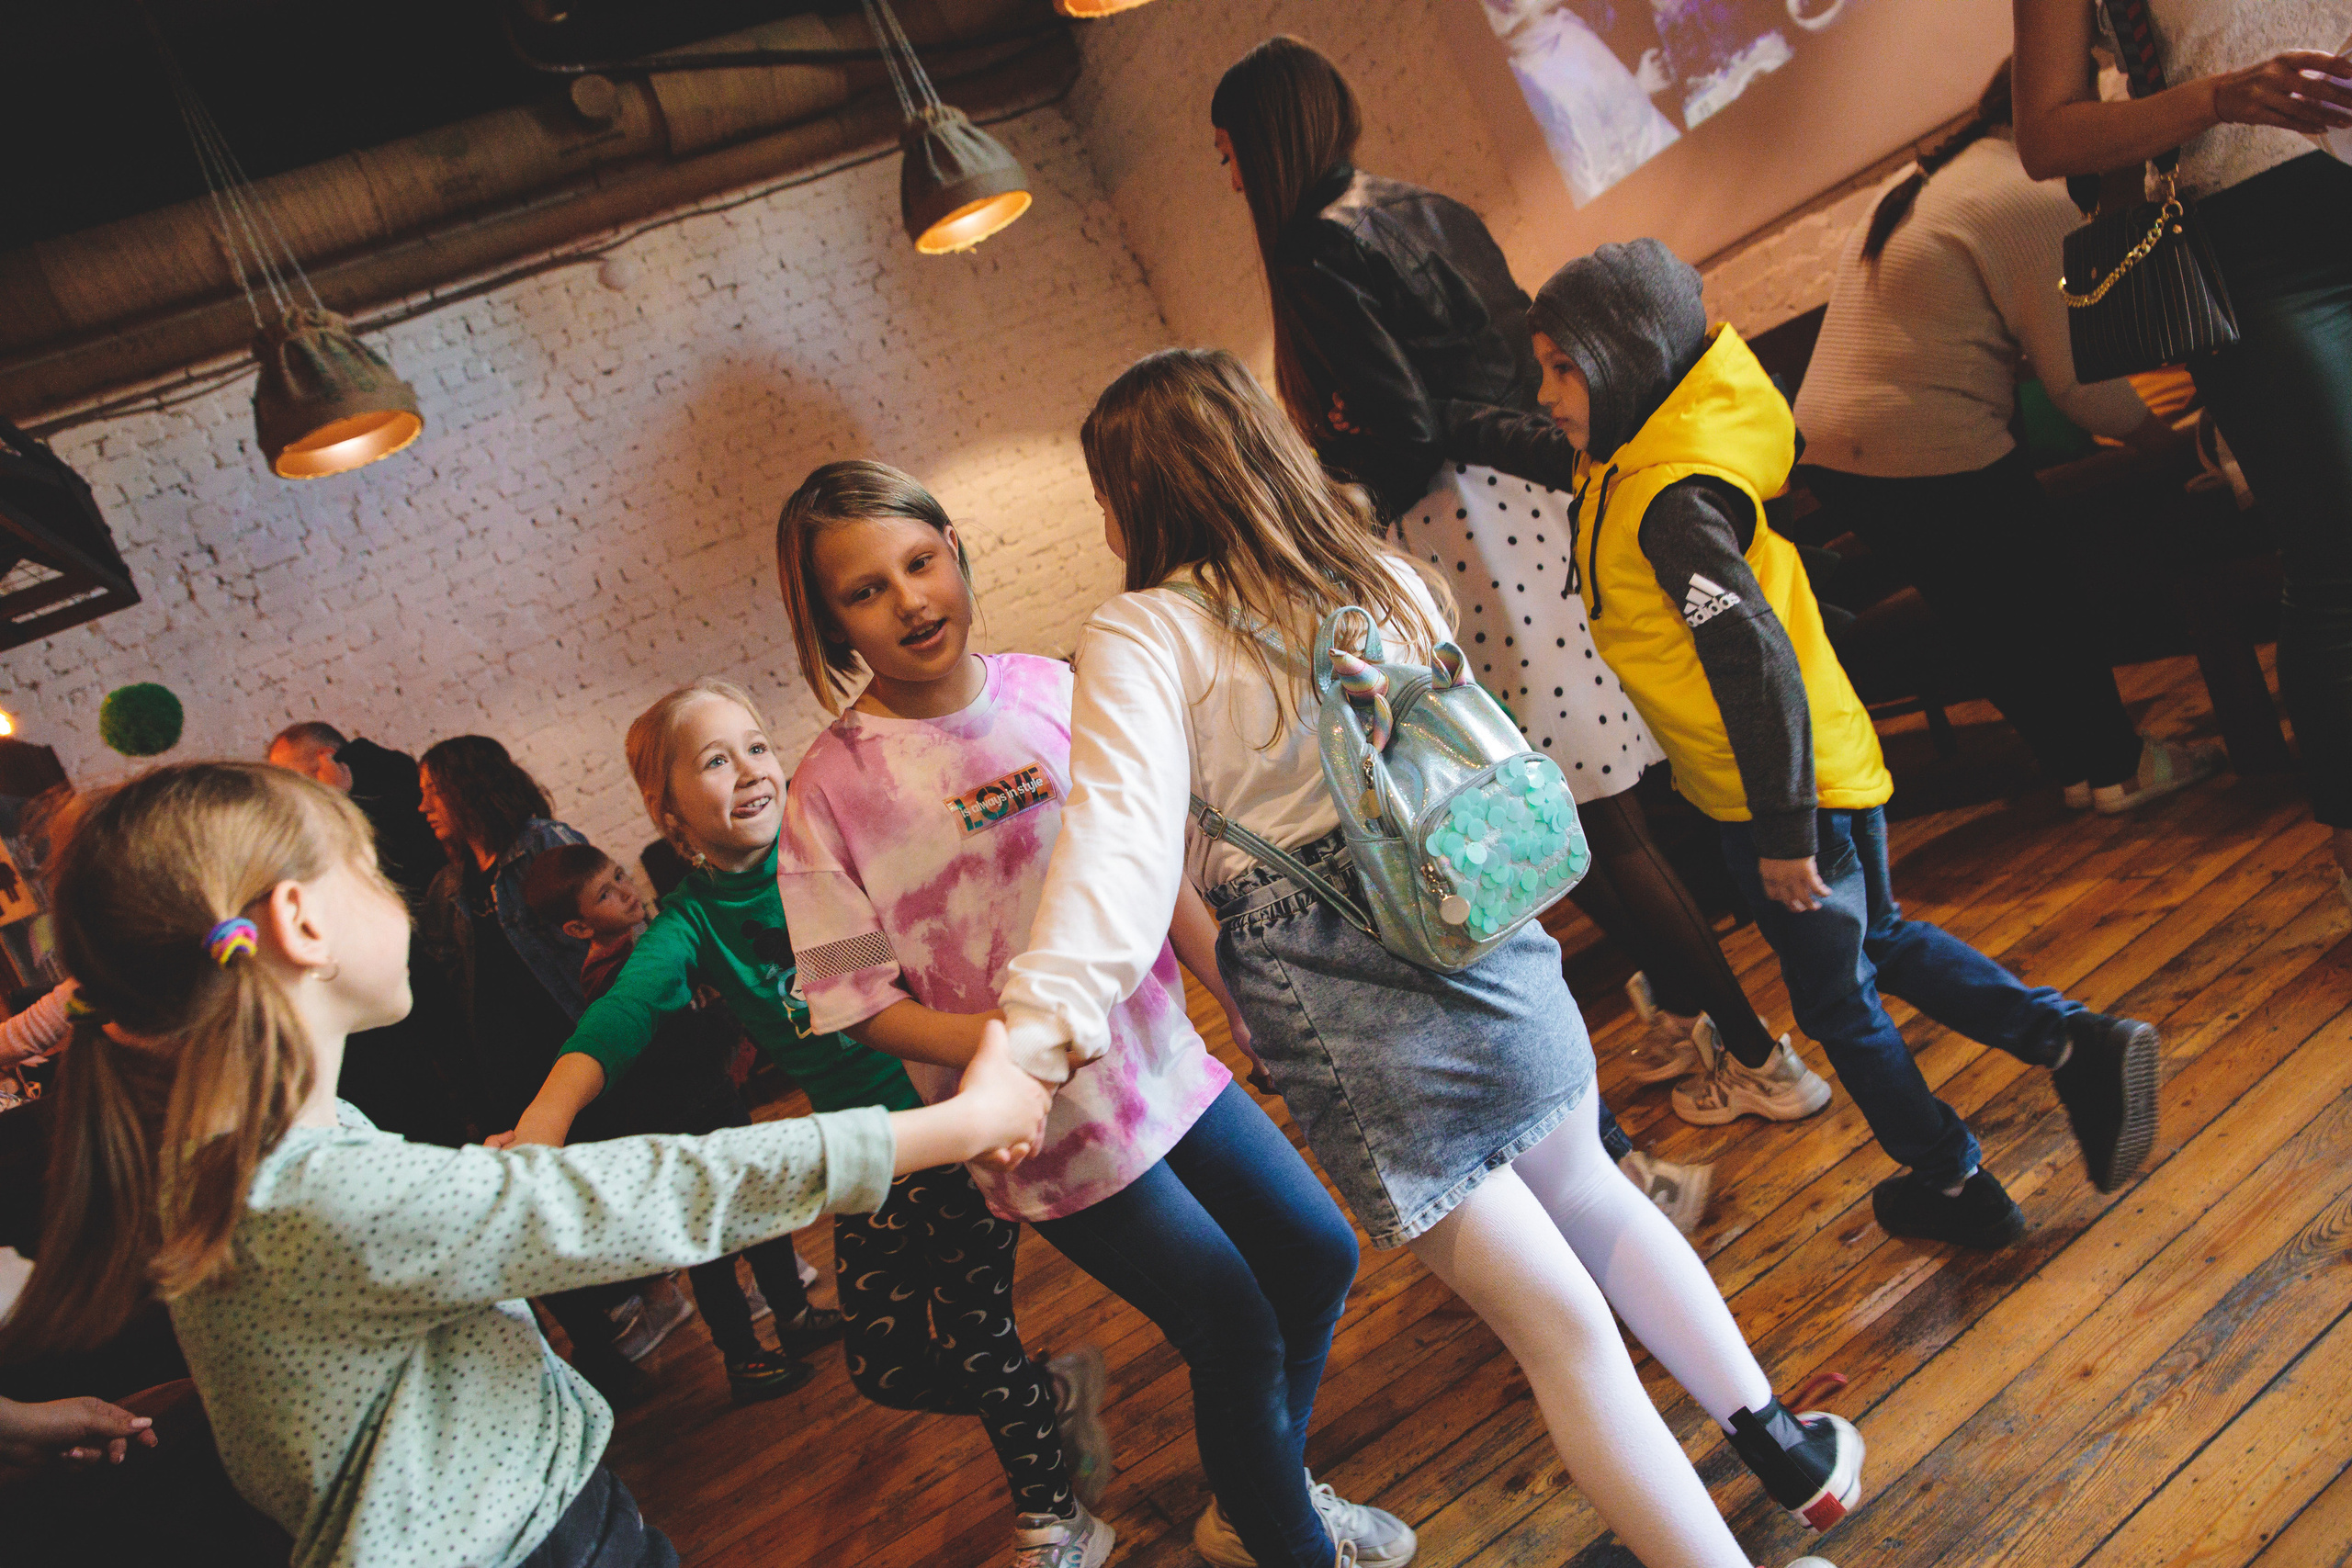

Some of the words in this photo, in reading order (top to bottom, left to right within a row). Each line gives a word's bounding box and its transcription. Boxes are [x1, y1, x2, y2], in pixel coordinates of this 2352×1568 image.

[1686, 592, 1741, 628] adidas
[954, 766, 1048, 831] LOVE
[958, 807, 971, 818] is
[971, 793, 1007, 813] always
[1005, 788, 1018, 799] in
[1017, 777, 1044, 795] style
